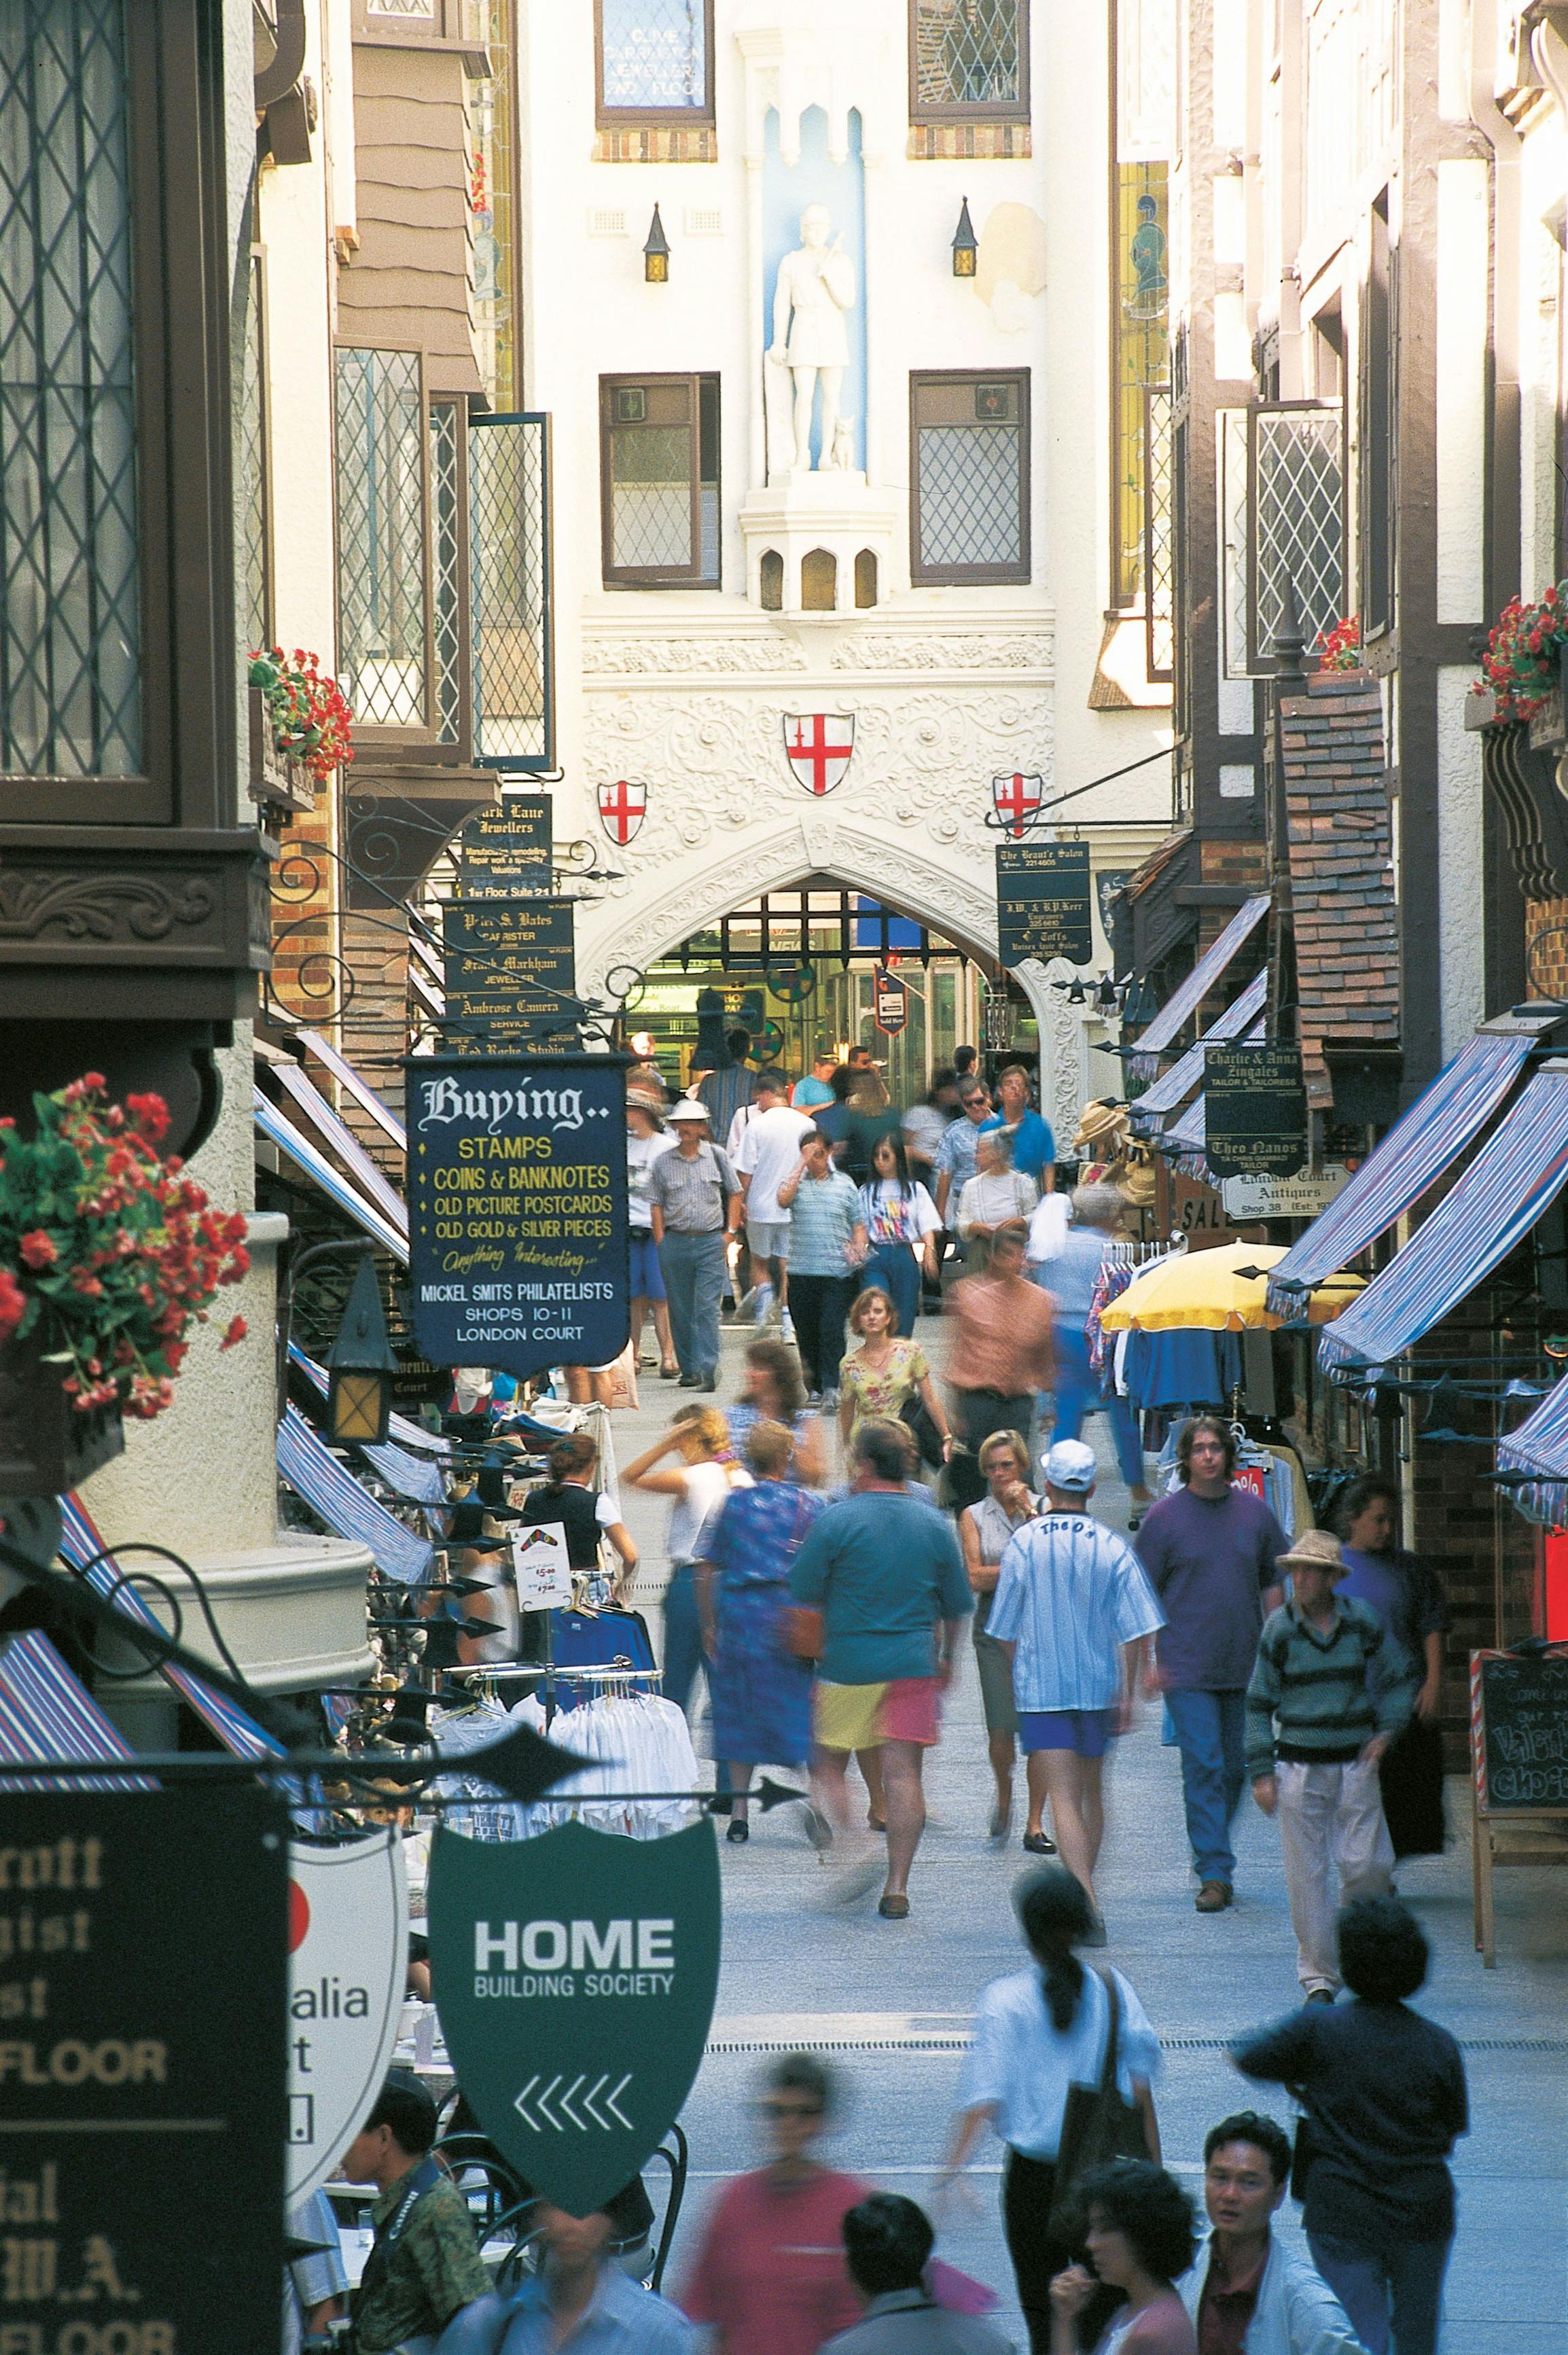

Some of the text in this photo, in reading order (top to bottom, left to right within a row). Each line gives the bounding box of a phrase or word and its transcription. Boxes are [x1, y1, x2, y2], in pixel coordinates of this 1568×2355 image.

[511, 804, 544, 819] Lane
[480, 820, 534, 834] Jewellers
[535, 887, 550, 896] 21
[518, 912, 553, 929] Bates
[501, 955, 557, 972] Markham
[461, 998, 559, 1018] Ambrose Camera
[1207, 1051, 1298, 1065] Charlie & Anna
[458, 1136, 552, 1159] STAMPS
[1211, 1141, 1246, 1154] Theo
[1240, 1161, 1269, 1169] TAILOR
[434, 1165, 609, 1190] COINS & BANKNOTES
[1258, 1187, 1321, 1200] Antiques
[434, 1194, 612, 1215] OLD PICTURE POSTCARDS
[1241, 1205, 1264, 1214] Shop
[1268, 1203, 1281, 1211] 38
[435, 1220, 611, 1239] OLD GOLD & SILVER PIECES
[421, 1282, 613, 1303] MICKEL SMITS PHILATELISTS
[465, 1308, 523, 1322] SHOPS
[457, 1327, 584, 1341] LONDON COURT
[1040, 1521, 1069, 1535] The
[475, 1919, 675, 1970] HOME
[475, 1973, 675, 1997] BUILDING SOCIETY
[389, 2190, 419, 2240] Canon
